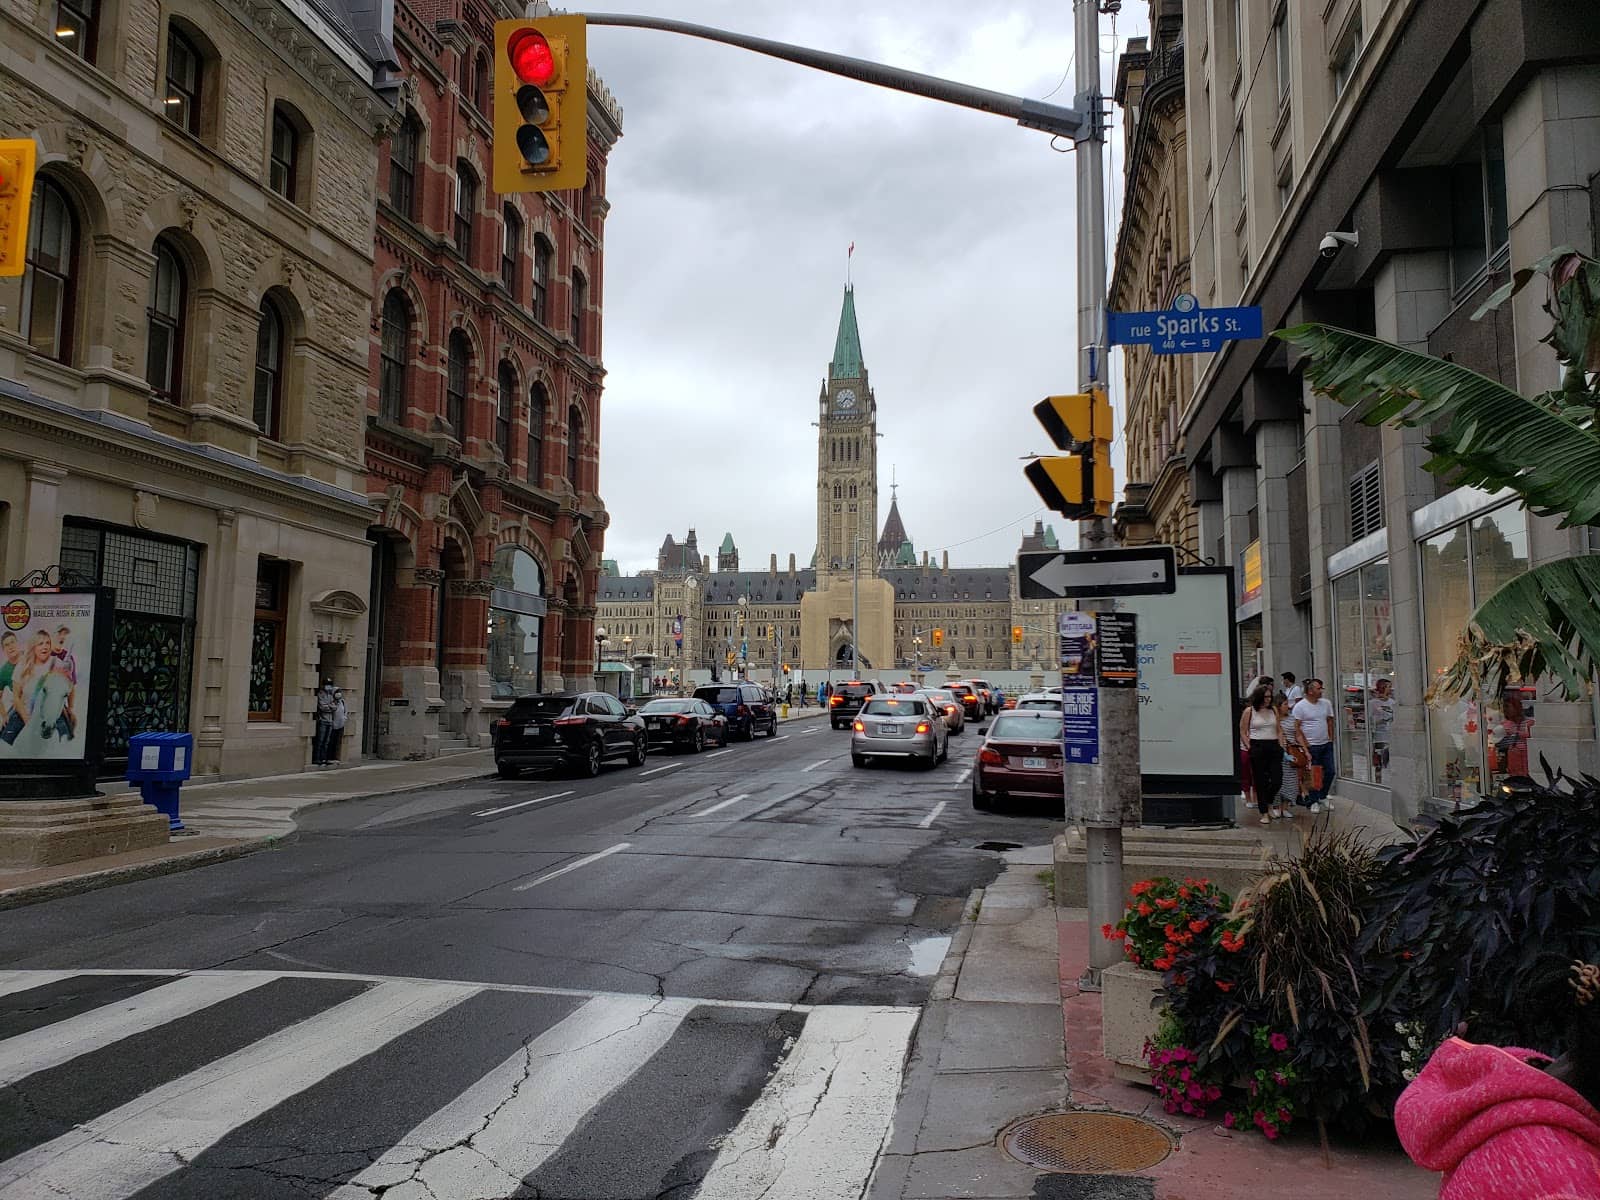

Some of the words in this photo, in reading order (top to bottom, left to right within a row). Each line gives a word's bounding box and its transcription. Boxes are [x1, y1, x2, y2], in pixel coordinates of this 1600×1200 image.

[1130, 326, 1151, 337] rue
[1156, 312, 1219, 340] Sparks
[1224, 318, 1241, 331] St.
[0, 605, 26, 615] HOT
[1077, 692, 1095, 704] RIDE
[1079, 703, 1092, 715] US!
